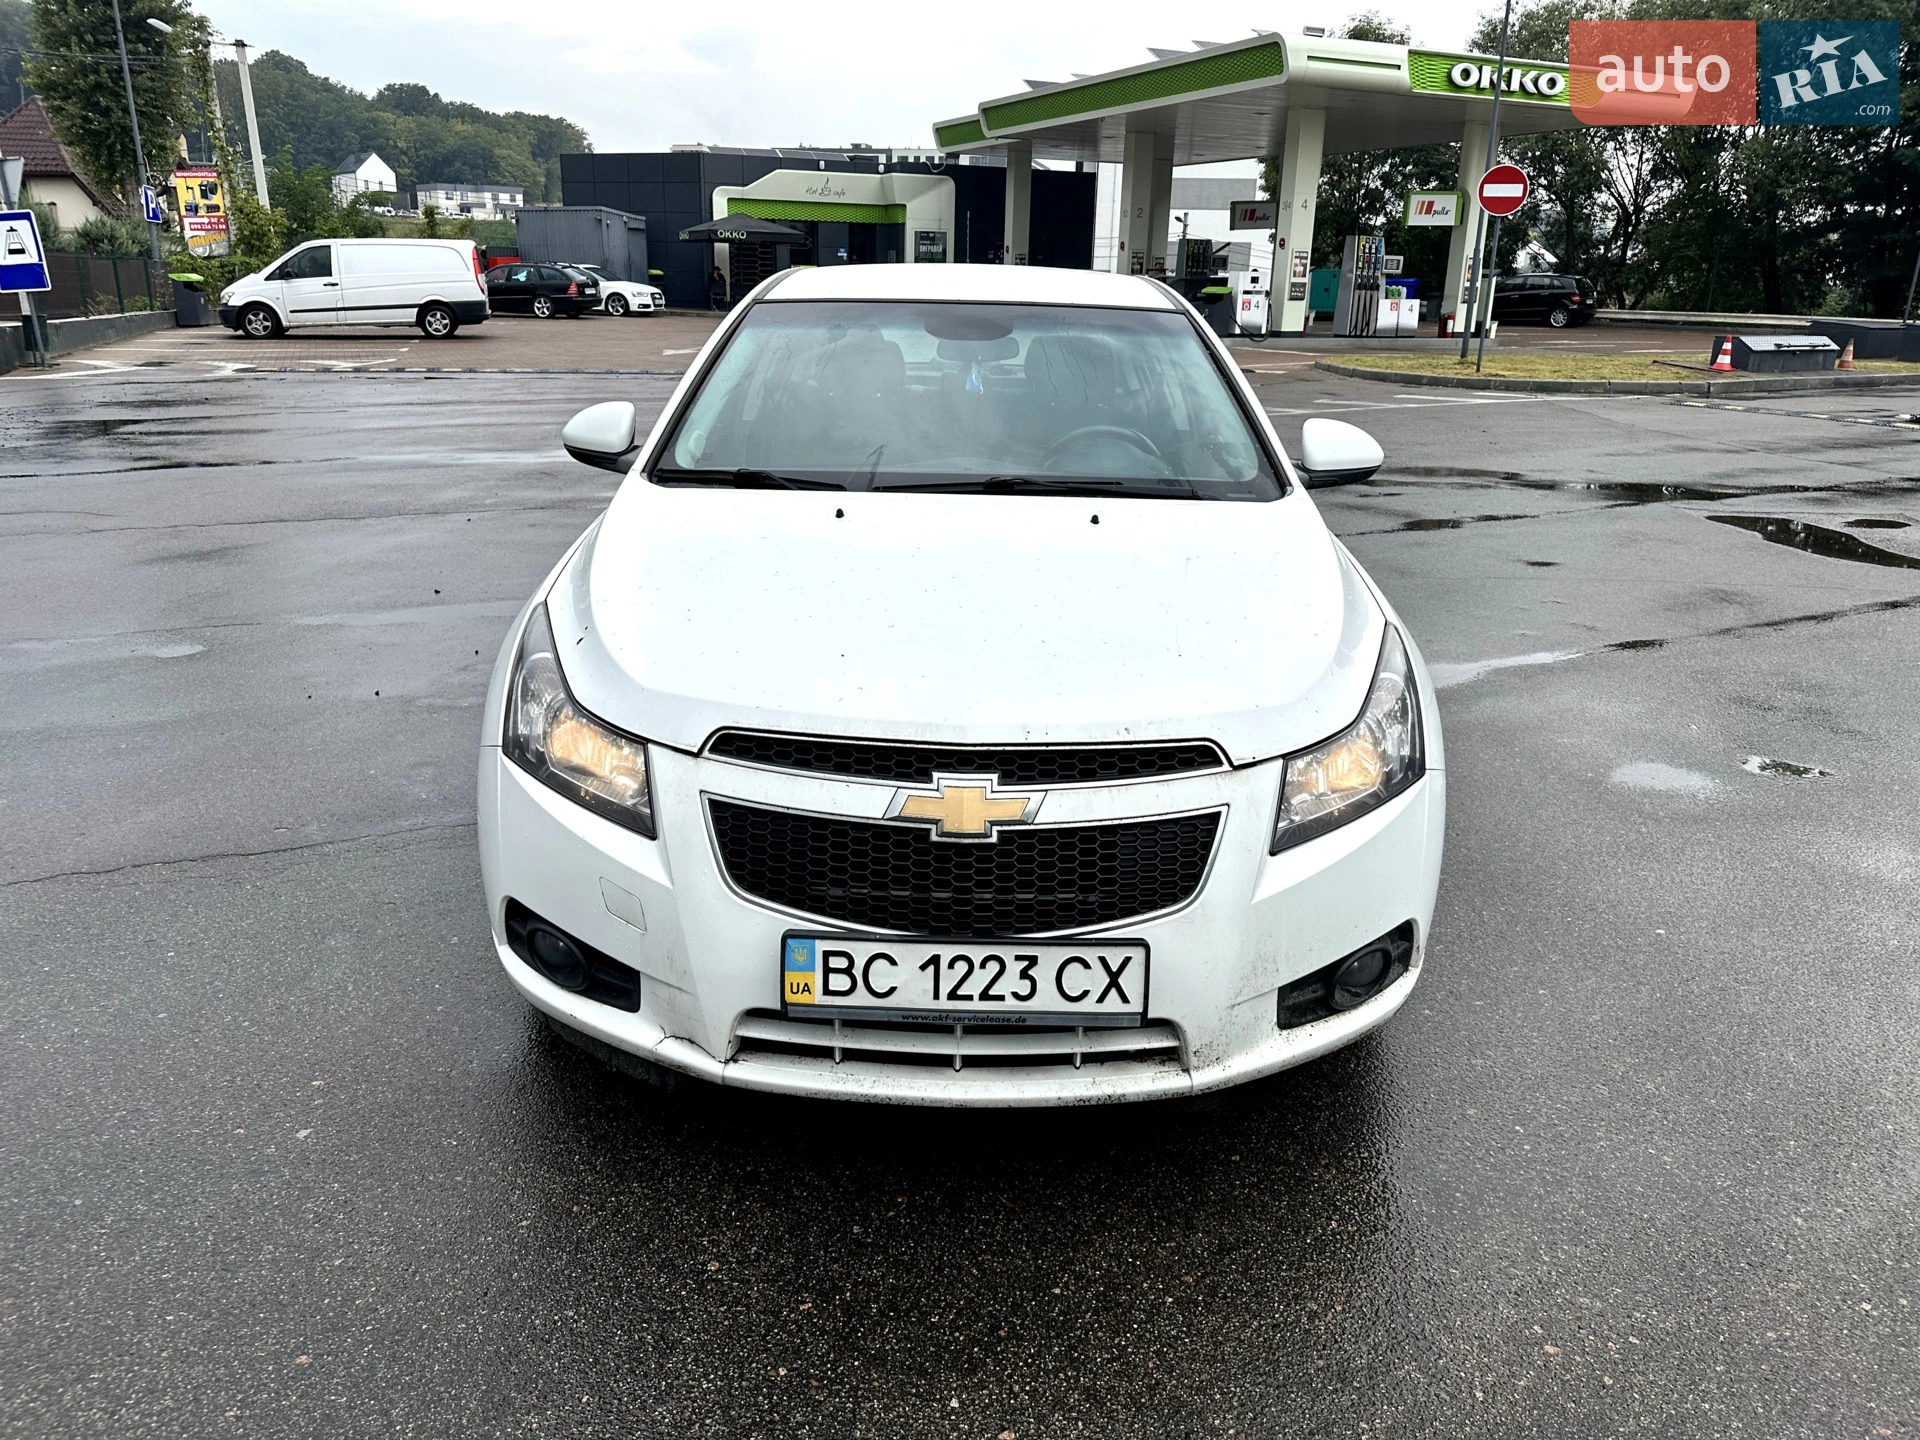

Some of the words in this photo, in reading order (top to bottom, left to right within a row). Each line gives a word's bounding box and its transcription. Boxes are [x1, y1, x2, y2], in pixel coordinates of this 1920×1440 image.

[1451, 62, 1566, 96] OKKO
[147, 190, 156, 217] P
[1301, 198, 1308, 211] 4
[1136, 207, 1144, 218] 2
[1431, 206, 1451, 218] pulls
[717, 229, 747, 239] OKKO
[1253, 300, 1260, 310] 4
[822, 949, 898, 999] BC
[918, 953, 1038, 1002] 1223
[1055, 955, 1133, 1004] CX
[789, 982, 812, 996] UA
[901, 1013, 1027, 1024] www.akf-servicelease.de
